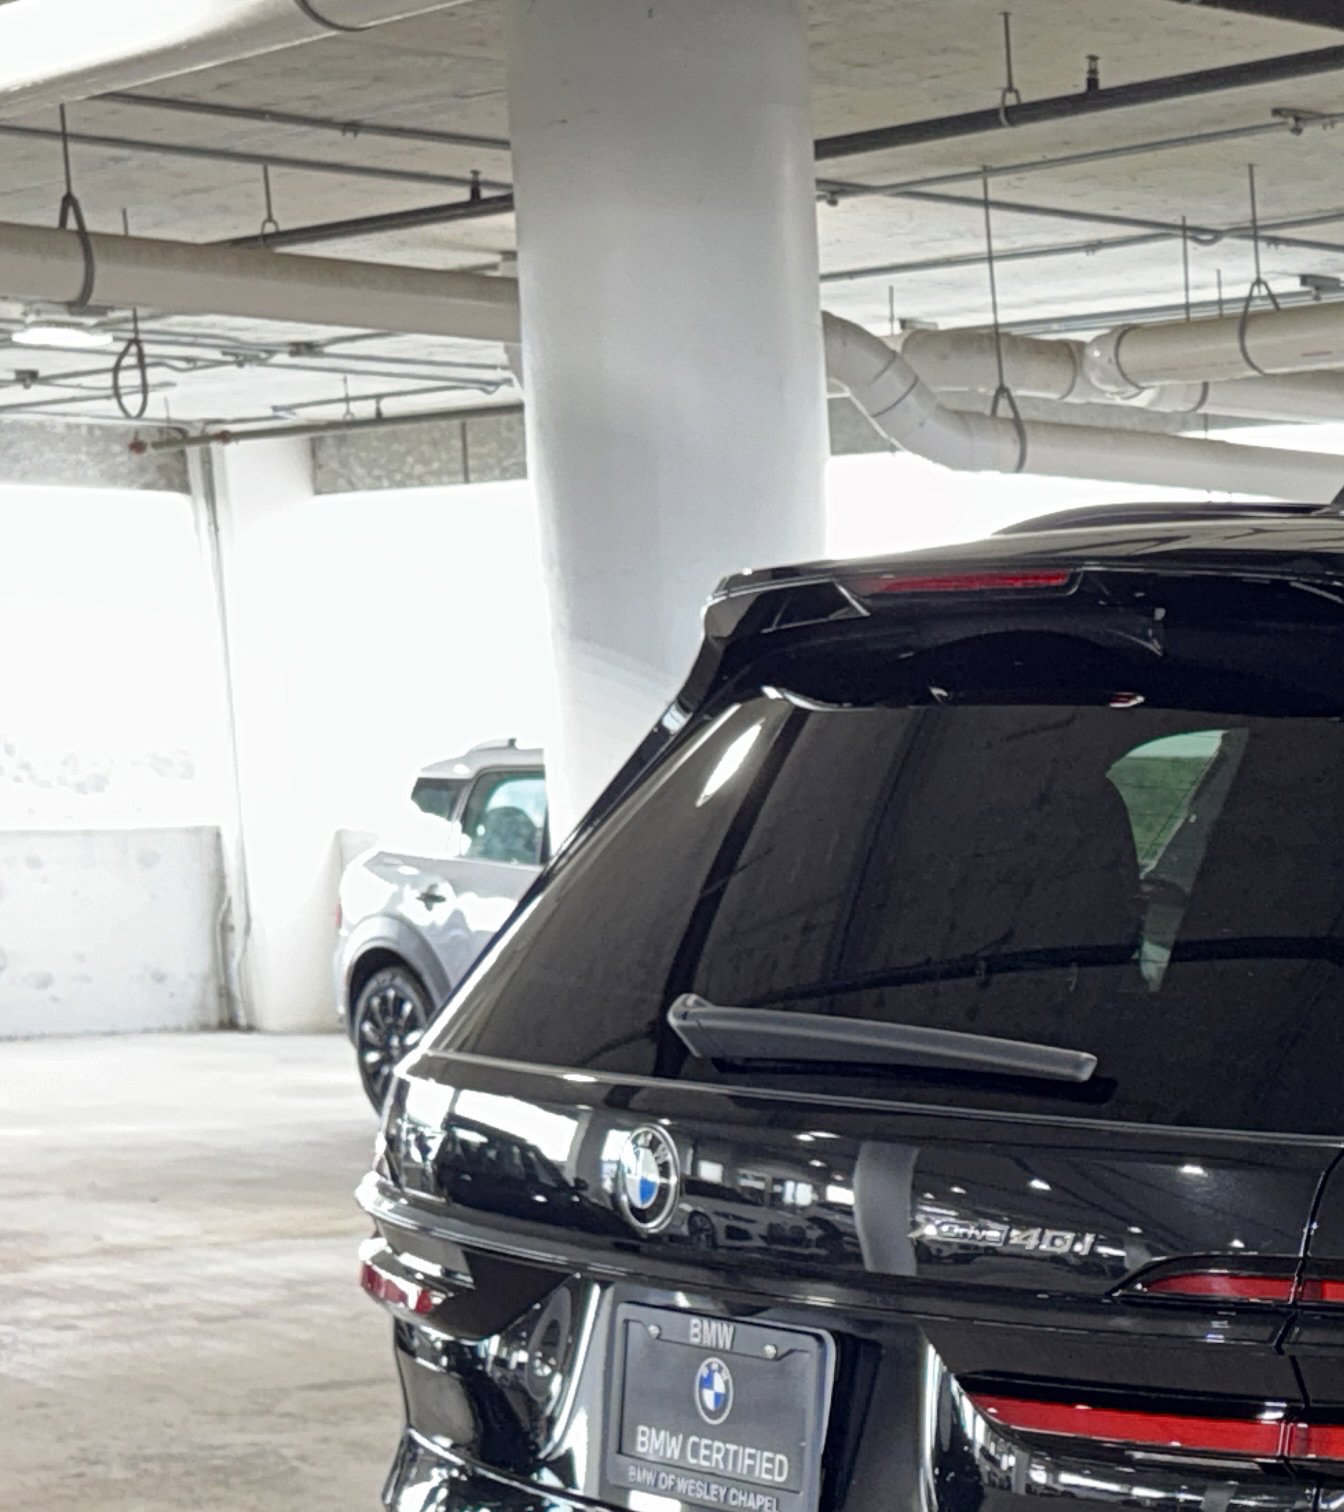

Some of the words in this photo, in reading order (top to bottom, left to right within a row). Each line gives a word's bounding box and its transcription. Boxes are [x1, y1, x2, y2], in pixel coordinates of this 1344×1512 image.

[689, 1318, 735, 1350] BMW
[636, 1425, 683, 1461] BMW
[686, 1435, 788, 1482] CERTIFIED
[628, 1465, 657, 1489] BMW
[658, 1473, 676, 1490] OF
[676, 1476, 728, 1504] WESLEY
